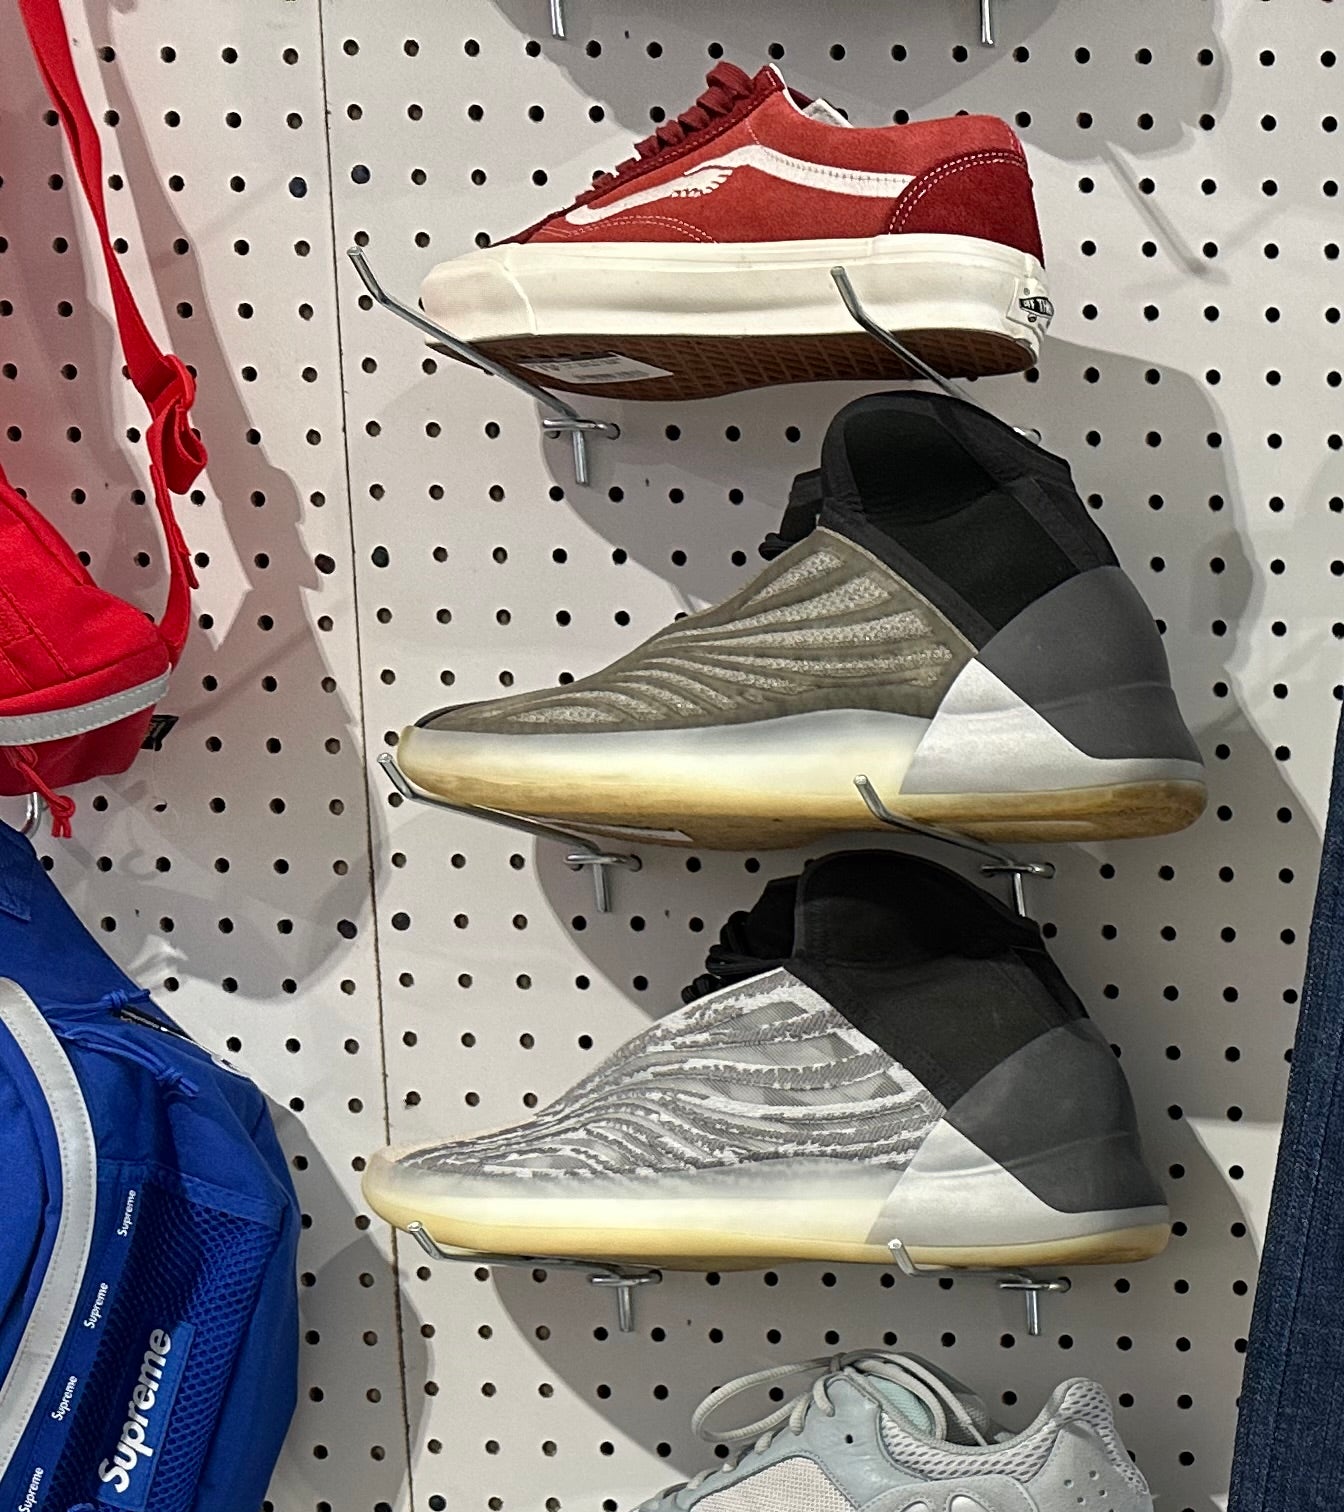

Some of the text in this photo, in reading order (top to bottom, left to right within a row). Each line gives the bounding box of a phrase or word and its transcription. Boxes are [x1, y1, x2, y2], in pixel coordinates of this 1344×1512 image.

[83, 1281, 109, 1329] Supreme
[51, 1374, 78, 1421] Supreme
[98, 1327, 172, 1494] Supreme
